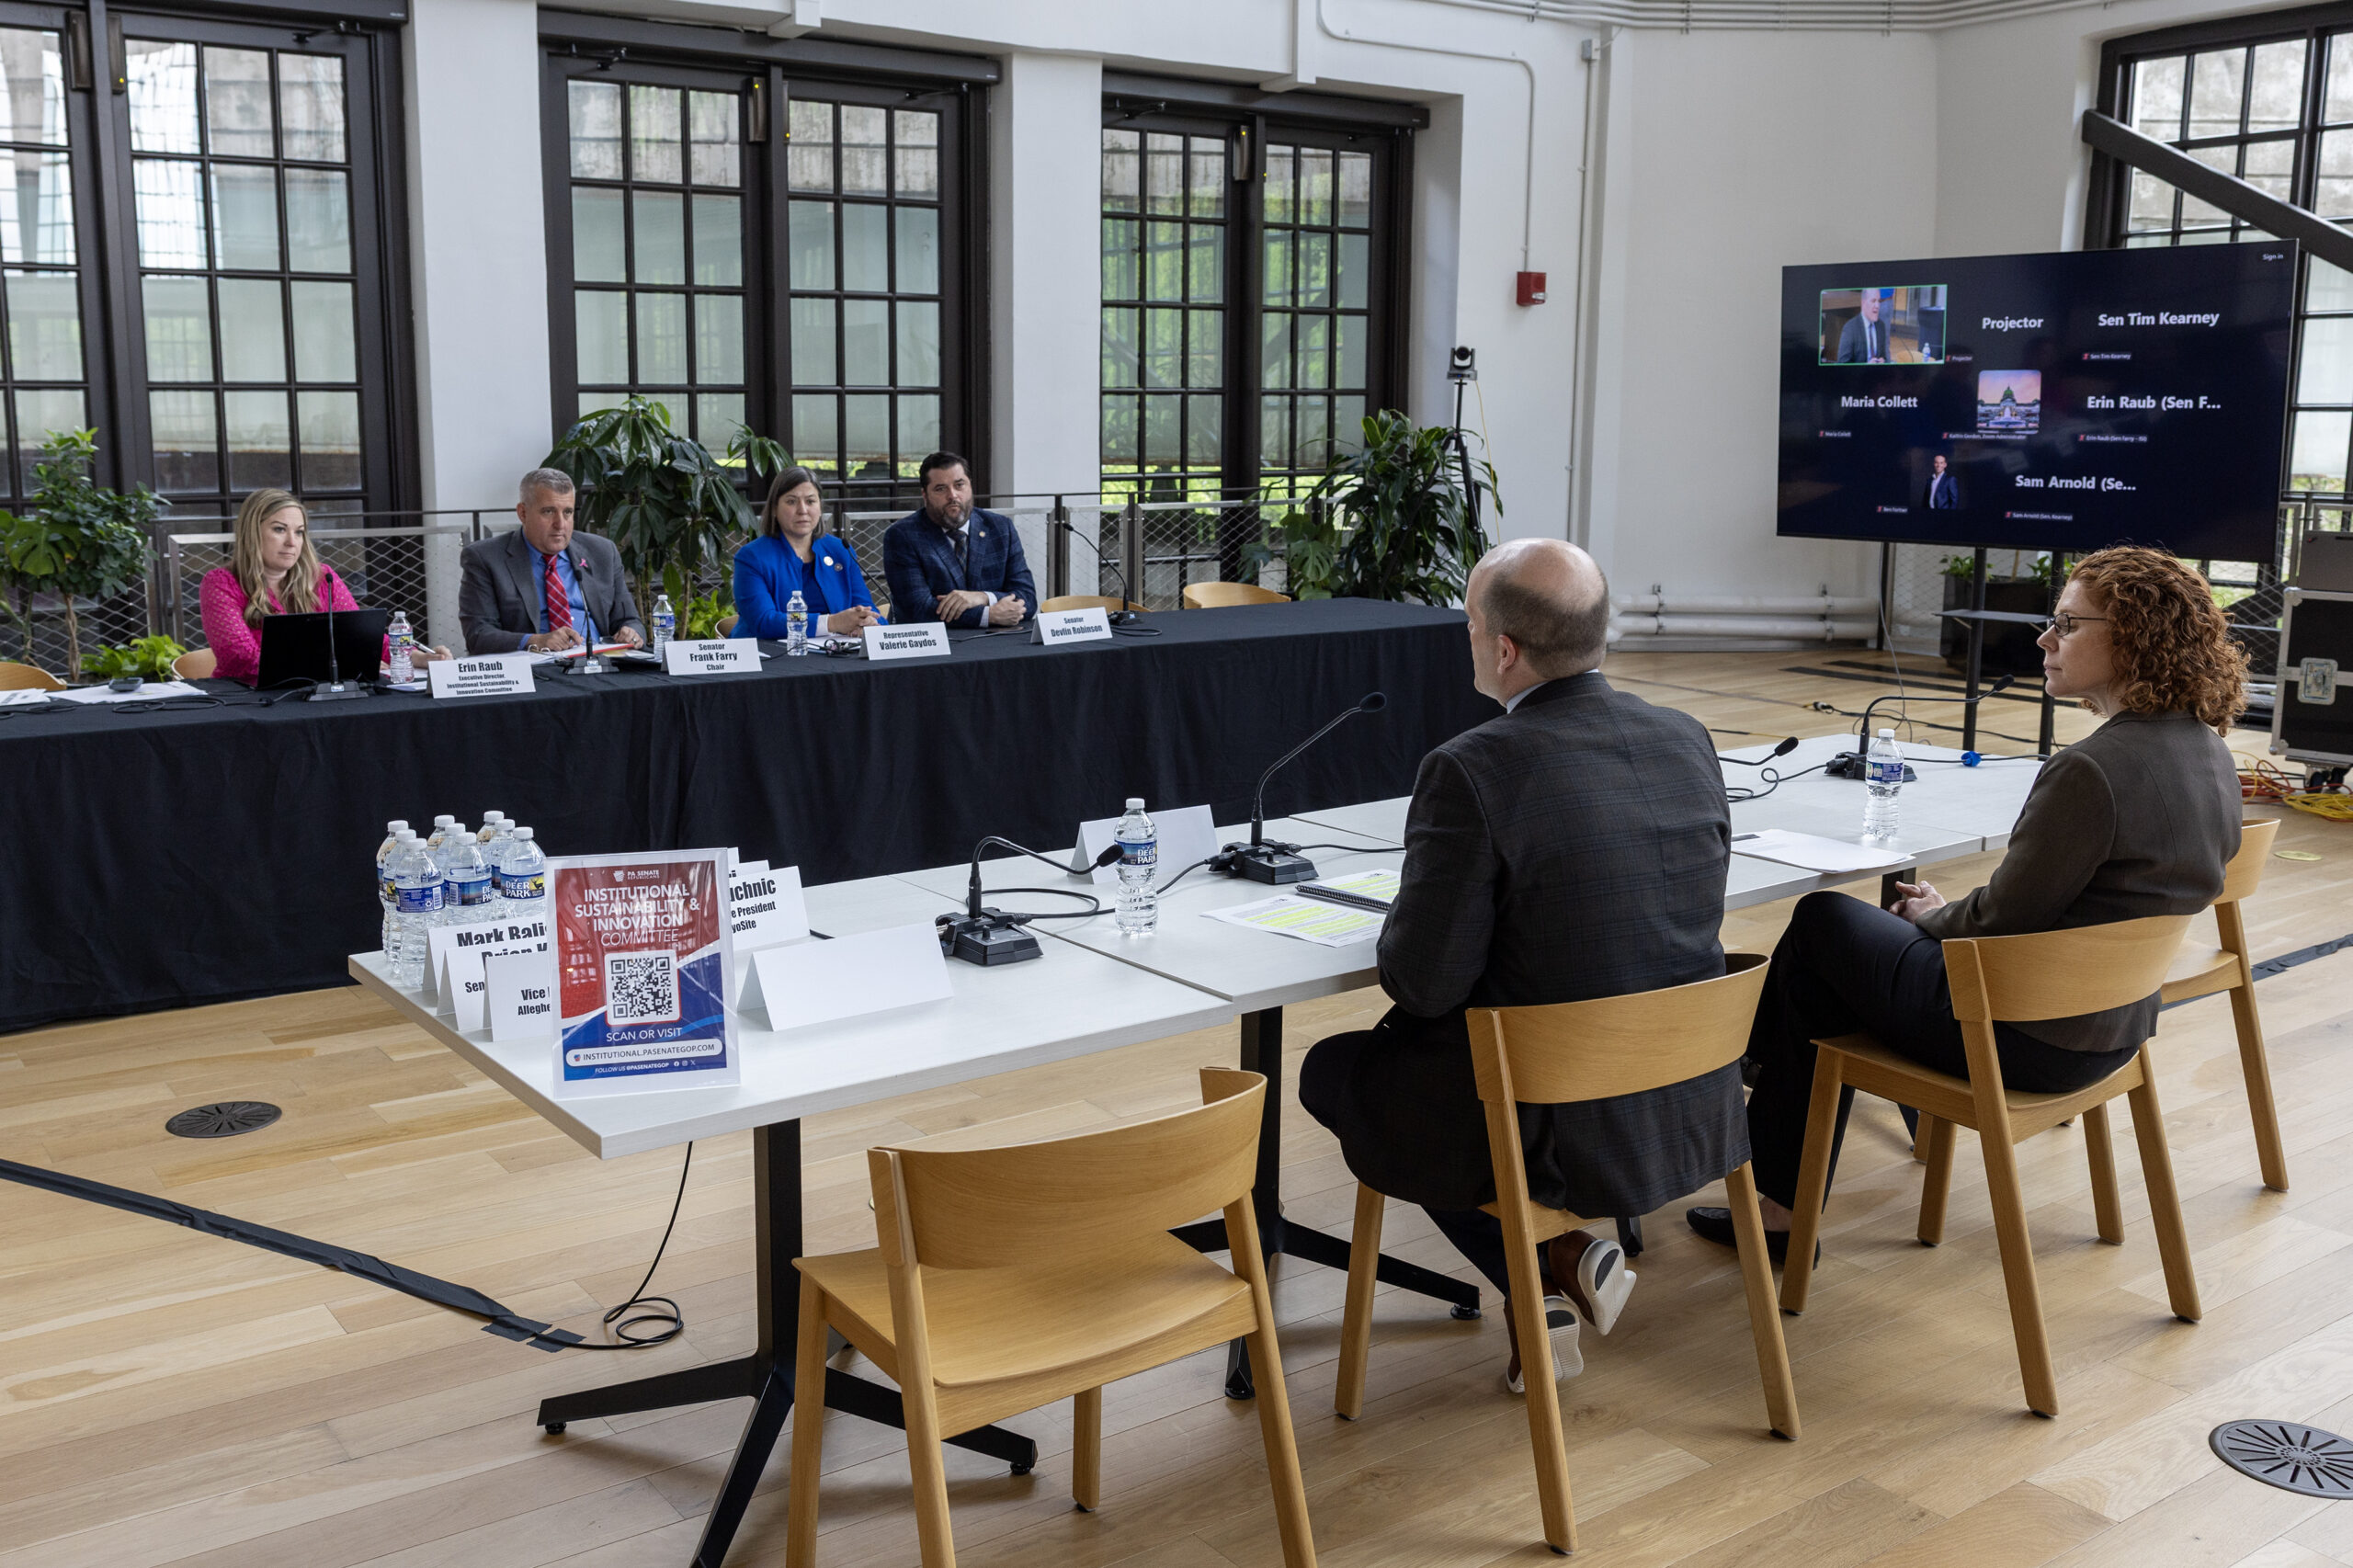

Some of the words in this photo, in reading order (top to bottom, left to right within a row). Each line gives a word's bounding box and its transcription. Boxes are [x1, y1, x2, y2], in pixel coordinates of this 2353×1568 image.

[2262, 253, 2277, 261] Sign
[1982, 316, 2044, 333] Projector
[2098, 313, 2124, 326] Sen
[2128, 312, 2155, 325] Tim
[2160, 312, 2220, 327] Kearney
[1841, 396, 1875, 408] Maria
[1877, 395, 1918, 408] Collett
[2086, 395, 2114, 409] Erin
[2120, 395, 2156, 409] Raub
[2161, 396, 2193, 411] (Sen
[2015, 475, 2044, 487] Sam
[2048, 476, 2096, 489] Arnold
[2101, 477, 2136, 492] (Se...
[883, 631, 928, 639] Representative
[1051, 629, 1072, 637] Devlin
[1072, 625, 1103, 634] Robinson
[880, 641, 908, 651] Valerie
[908, 639, 938, 648] Gaydos
[689, 653, 714, 662] Frank
[717, 653, 737, 661] Farry
[458, 663, 476, 673] Erin
[478, 662, 502, 671] Raub
[506, 881, 529, 890] DEER
[506, 889, 531, 899] PARK
[585, 884, 689, 903] INSTITUTIONAL
[575, 899, 686, 917] SUSTAINABILITY
[689, 897, 700, 911] &
[737, 901, 776, 917] President
[594, 915, 684, 932] INNOVATION
[456, 928, 505, 947] Mark
[508, 923, 547, 939] Rali
[601, 928, 679, 947] COMMITTEE
[520, 988, 546, 1000] Vice
[607, 1031, 636, 1042] SCAN
[640, 1029, 654, 1039] OR
[656, 1028, 682, 1038] VISIT
[583, 1044, 715, 1061] INSTITUTIONAL.PASENATEGOP.COM
[626, 1062, 669, 1071] @PASENATEGOP
